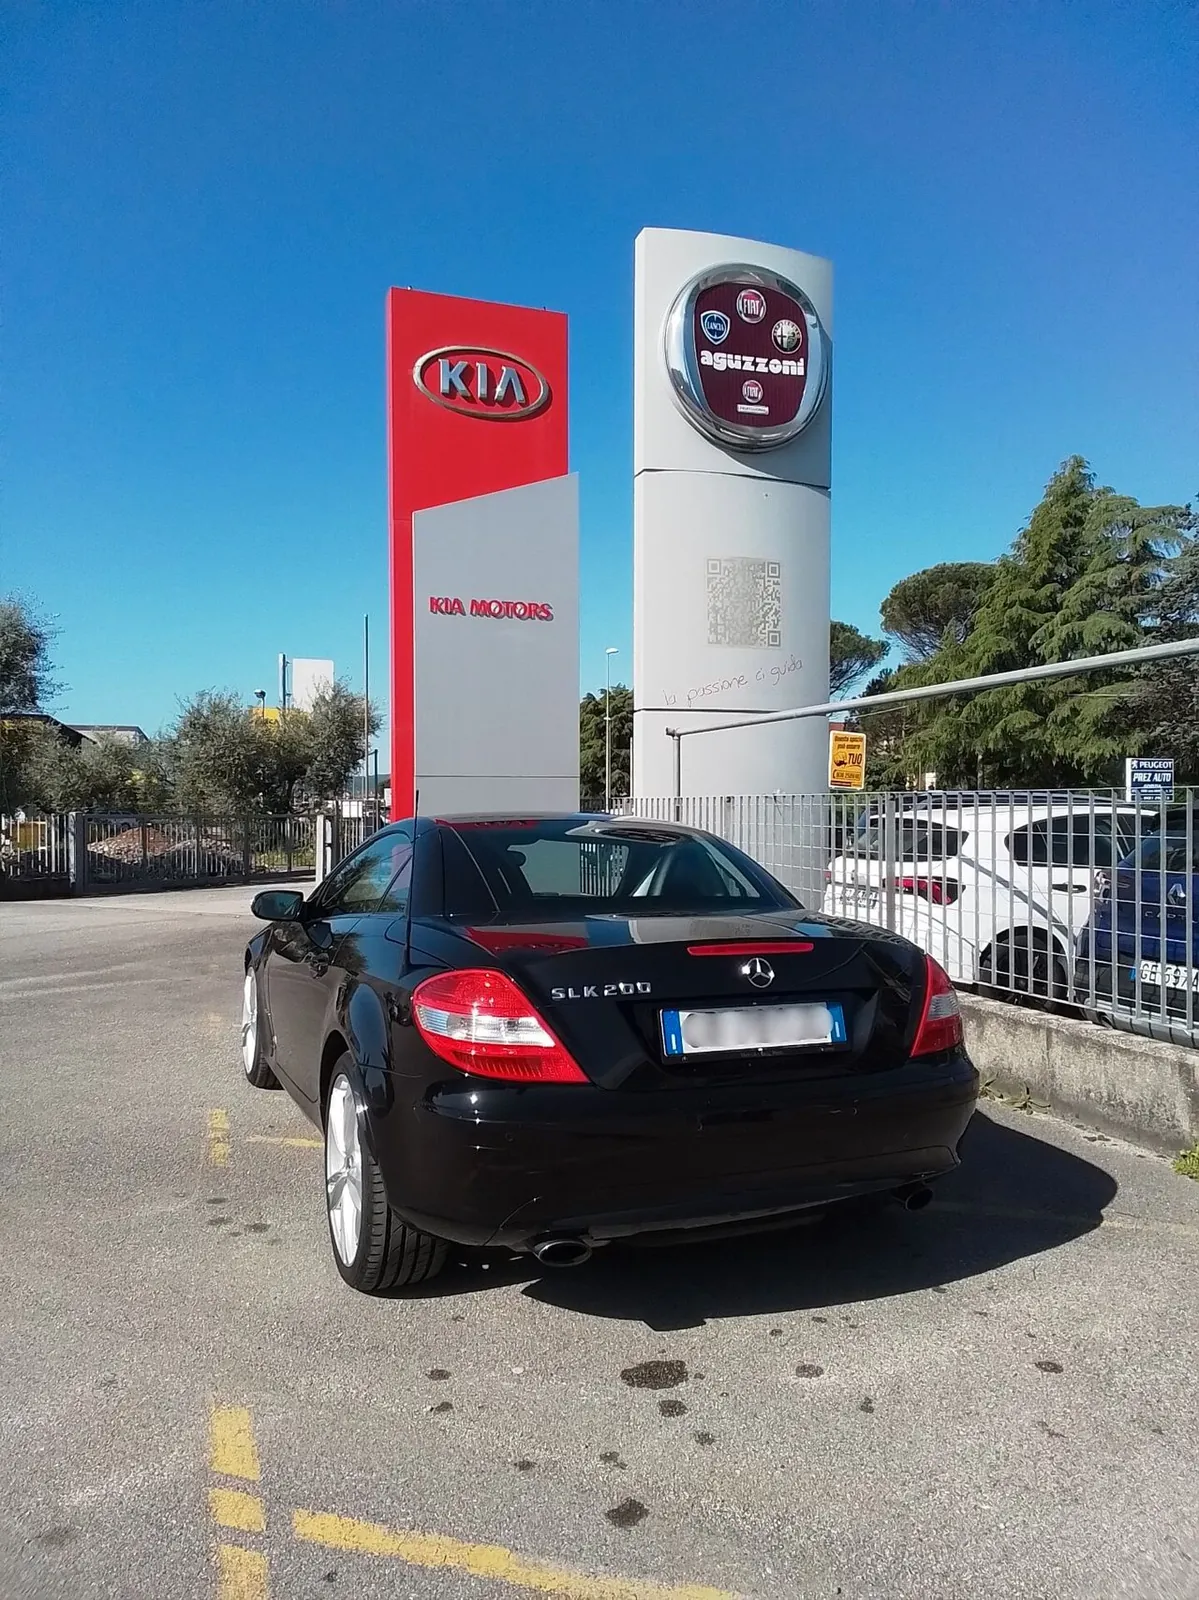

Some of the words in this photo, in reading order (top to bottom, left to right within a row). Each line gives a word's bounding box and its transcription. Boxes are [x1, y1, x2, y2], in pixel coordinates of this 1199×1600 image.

[743, 298, 760, 316] FIAT
[700, 350, 805, 376] aguzzoni
[438, 358, 526, 405] KIA
[429, 596, 466, 616] KIA
[470, 599, 554, 621] MOTORS
[662, 689, 676, 706] la
[687, 675, 748, 707] passione
[755, 667, 765, 681] ci
[771, 654, 803, 686] guida
[848, 753, 863, 765] TUO
[1140, 761, 1173, 769] PEUGEOT
[1152, 772, 1172, 782] AUTO
[551, 983, 599, 1000] SLK
[603, 981, 652, 997] 200
